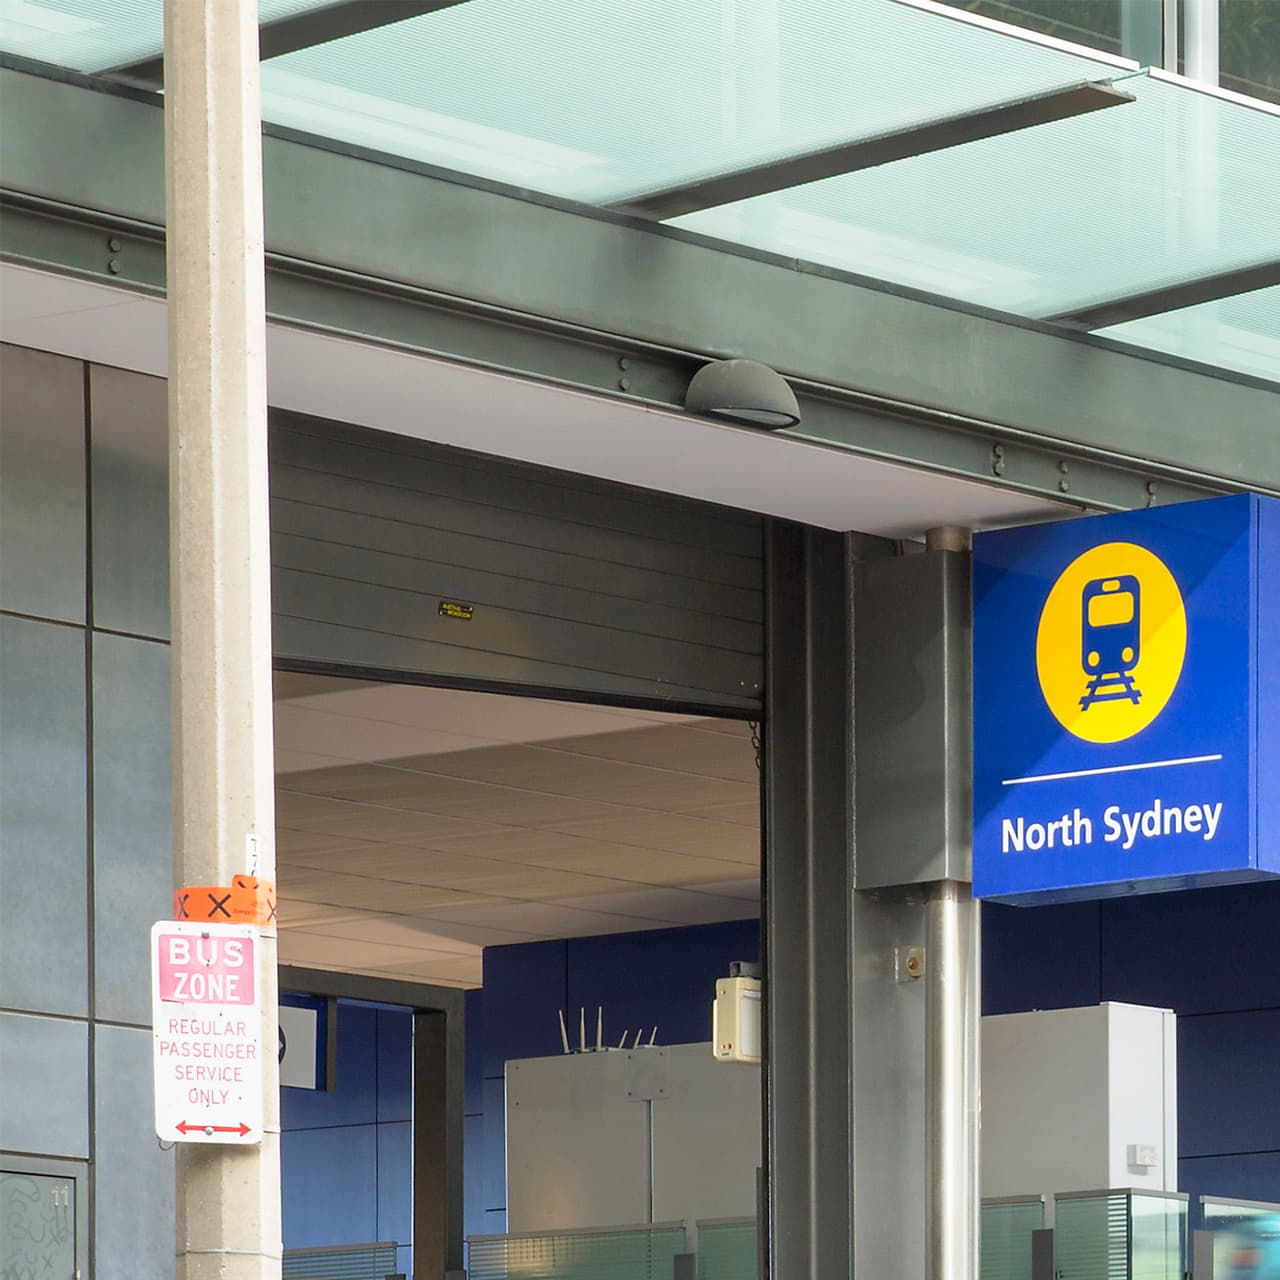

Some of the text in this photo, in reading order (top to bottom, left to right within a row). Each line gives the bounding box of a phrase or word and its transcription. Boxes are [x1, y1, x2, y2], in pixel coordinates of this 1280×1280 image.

[1002, 799, 1223, 853] North Sydney
[168, 937, 245, 969] BUS
[173, 972, 241, 1002] ZONE
[168, 1018, 247, 1037] REGULAR
[159, 1040, 257, 1061] PASSENGER
[175, 1064, 244, 1083] SERVICE
[187, 1088, 231, 1105] ONLY
